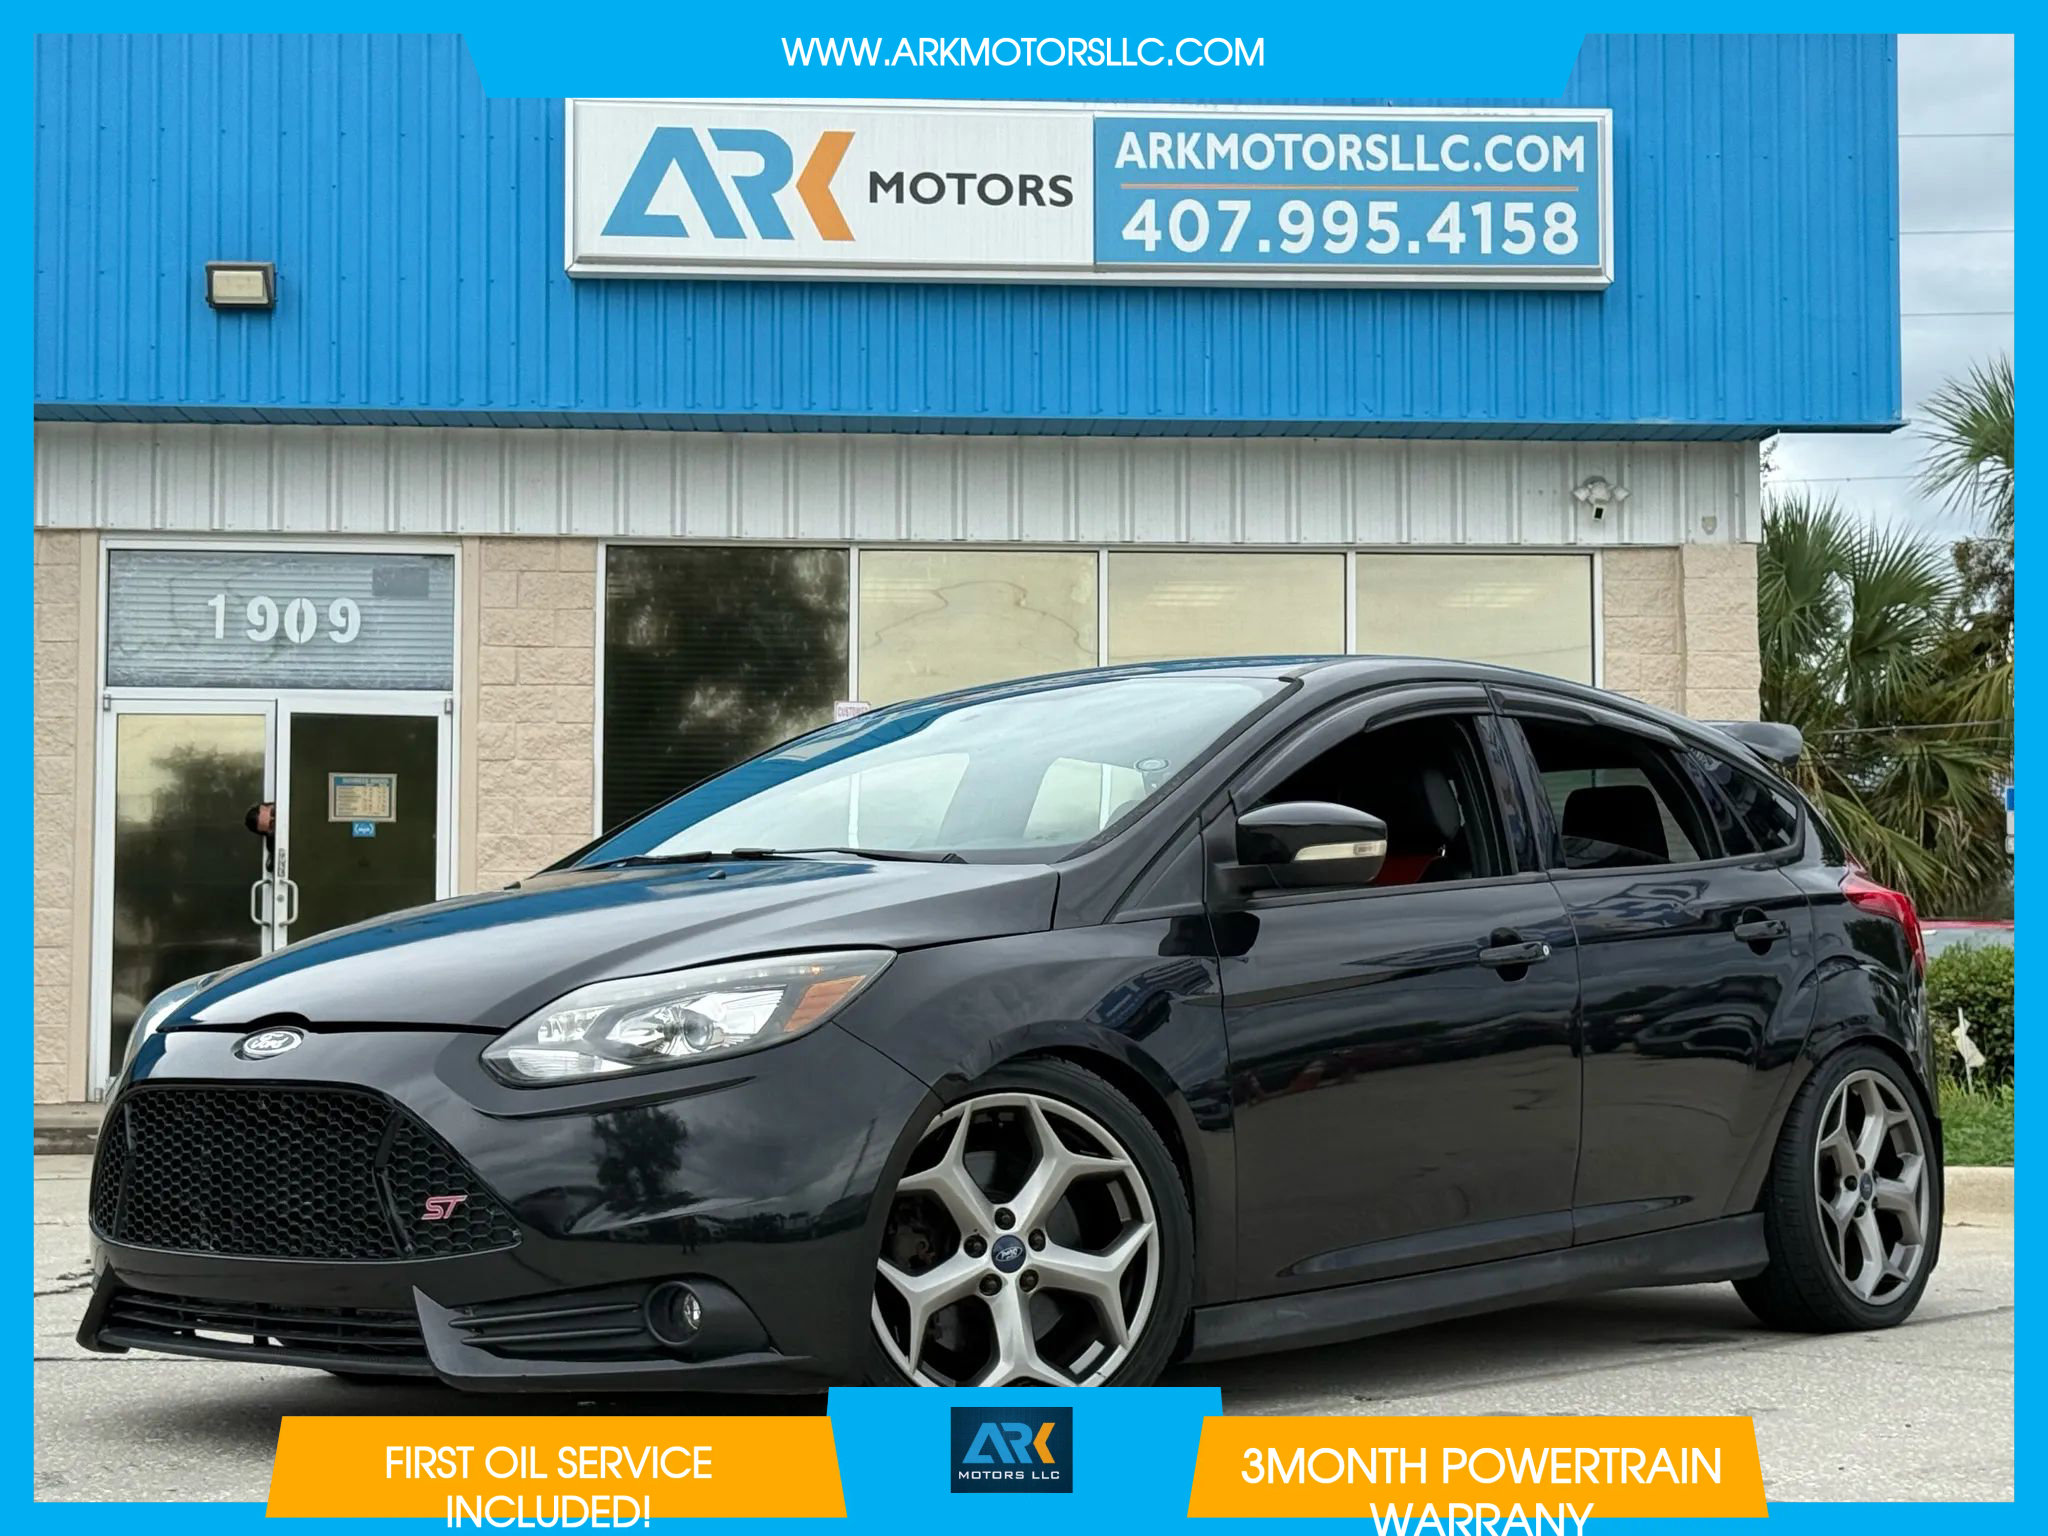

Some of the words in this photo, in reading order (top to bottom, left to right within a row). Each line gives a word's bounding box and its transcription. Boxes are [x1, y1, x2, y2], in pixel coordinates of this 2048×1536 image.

[1115, 131, 1585, 173] ARKMOTORSLLC.COM
[600, 126, 856, 242] ARK
[869, 171, 1073, 208] MOTORS
[1121, 198, 1579, 256] 407.995.4158
[208, 594, 361, 644] 1909
[250, 1031, 290, 1049] Ford
[421, 1194, 468, 1221] ST
